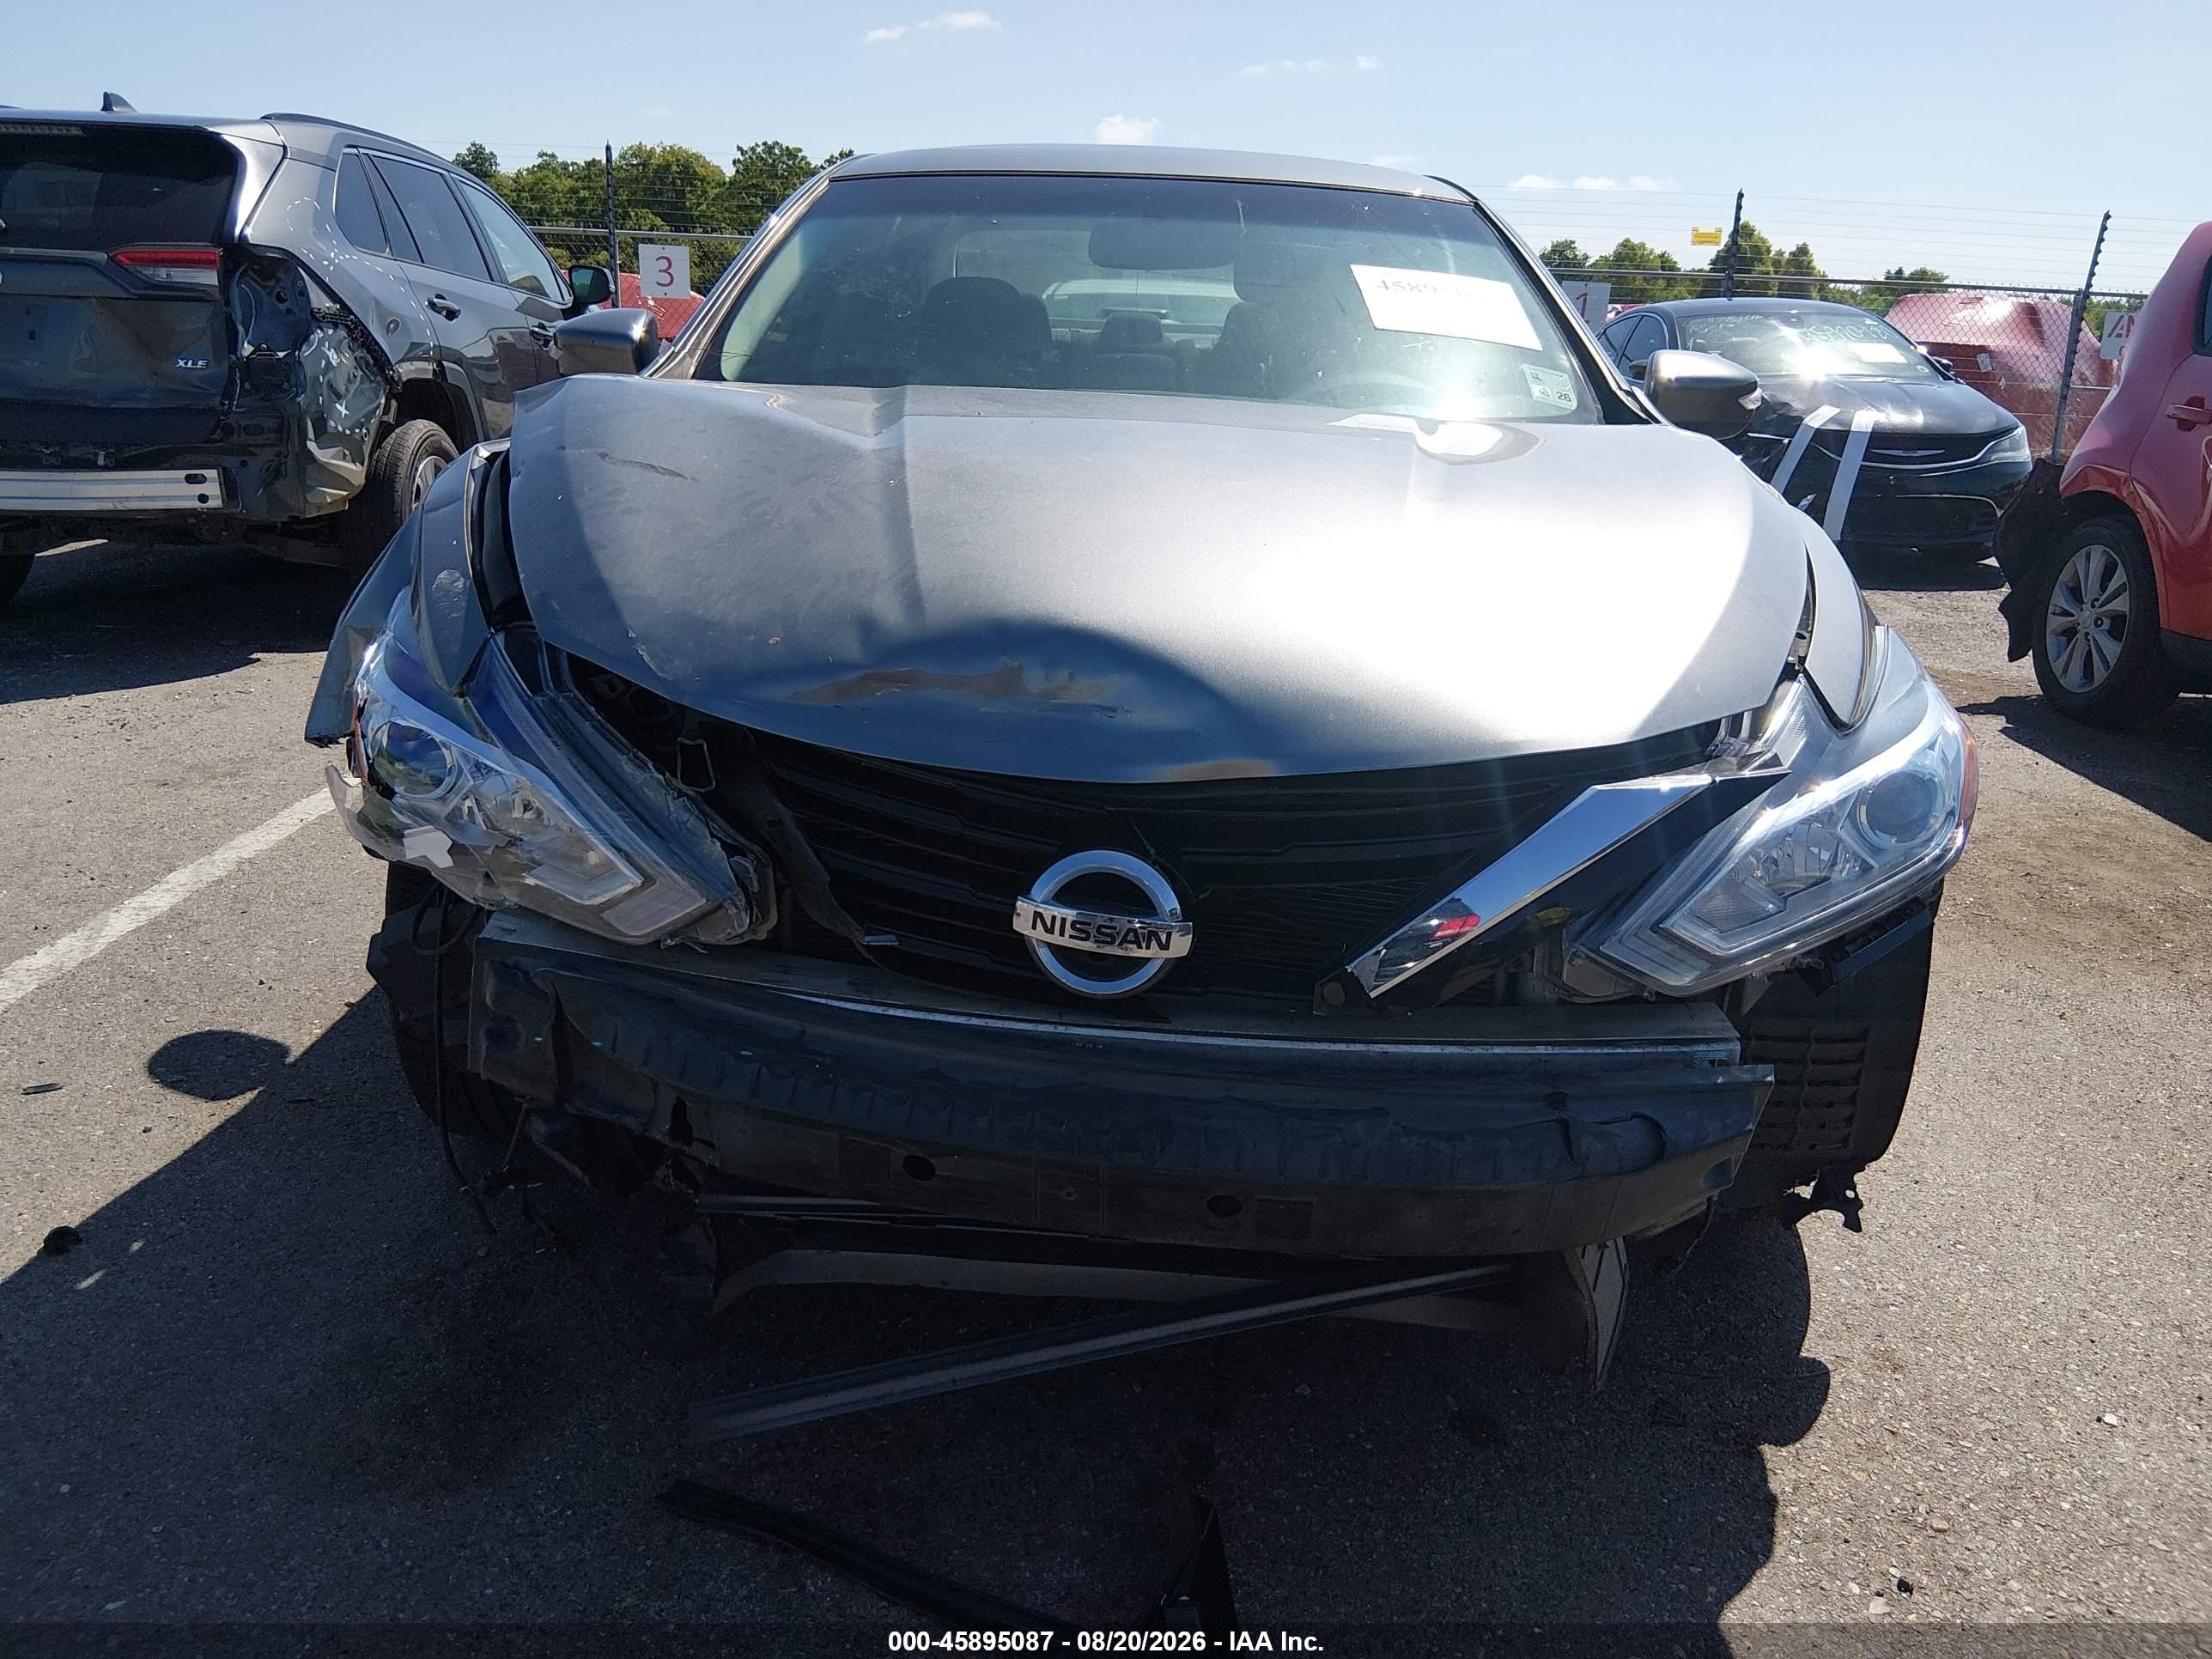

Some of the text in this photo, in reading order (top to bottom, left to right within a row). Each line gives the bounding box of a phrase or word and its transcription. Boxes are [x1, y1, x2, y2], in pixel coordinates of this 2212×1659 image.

[655, 255, 675, 288] 3
[1575, 291, 1589, 320] 1
[174, 358, 209, 369] XLE
[1556, 390, 1572, 403] 26
[1030, 909, 1174, 951] NISSAN
